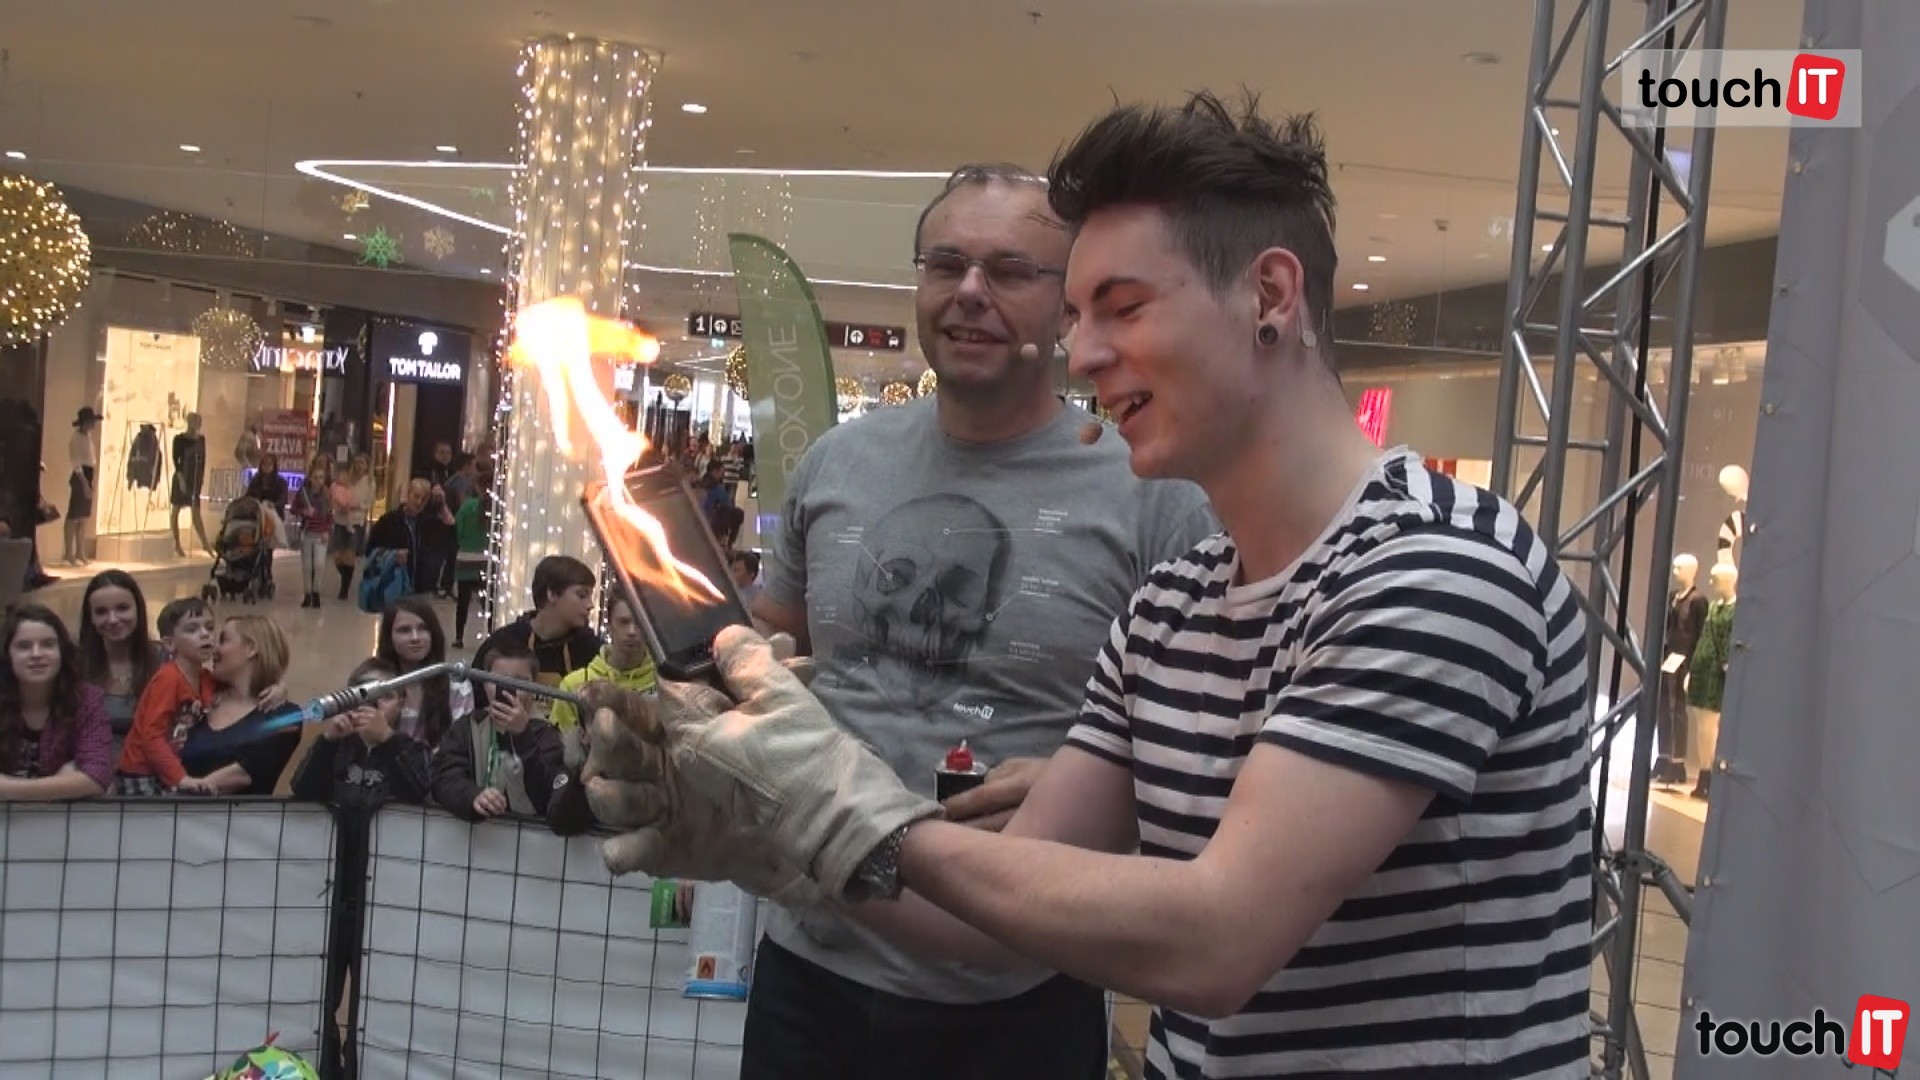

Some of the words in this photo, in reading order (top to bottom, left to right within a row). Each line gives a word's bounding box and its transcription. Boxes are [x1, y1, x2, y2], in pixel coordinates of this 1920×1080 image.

[695, 315, 706, 332] 1
[389, 357, 417, 377] TOM
[417, 360, 461, 380] TAILOR
